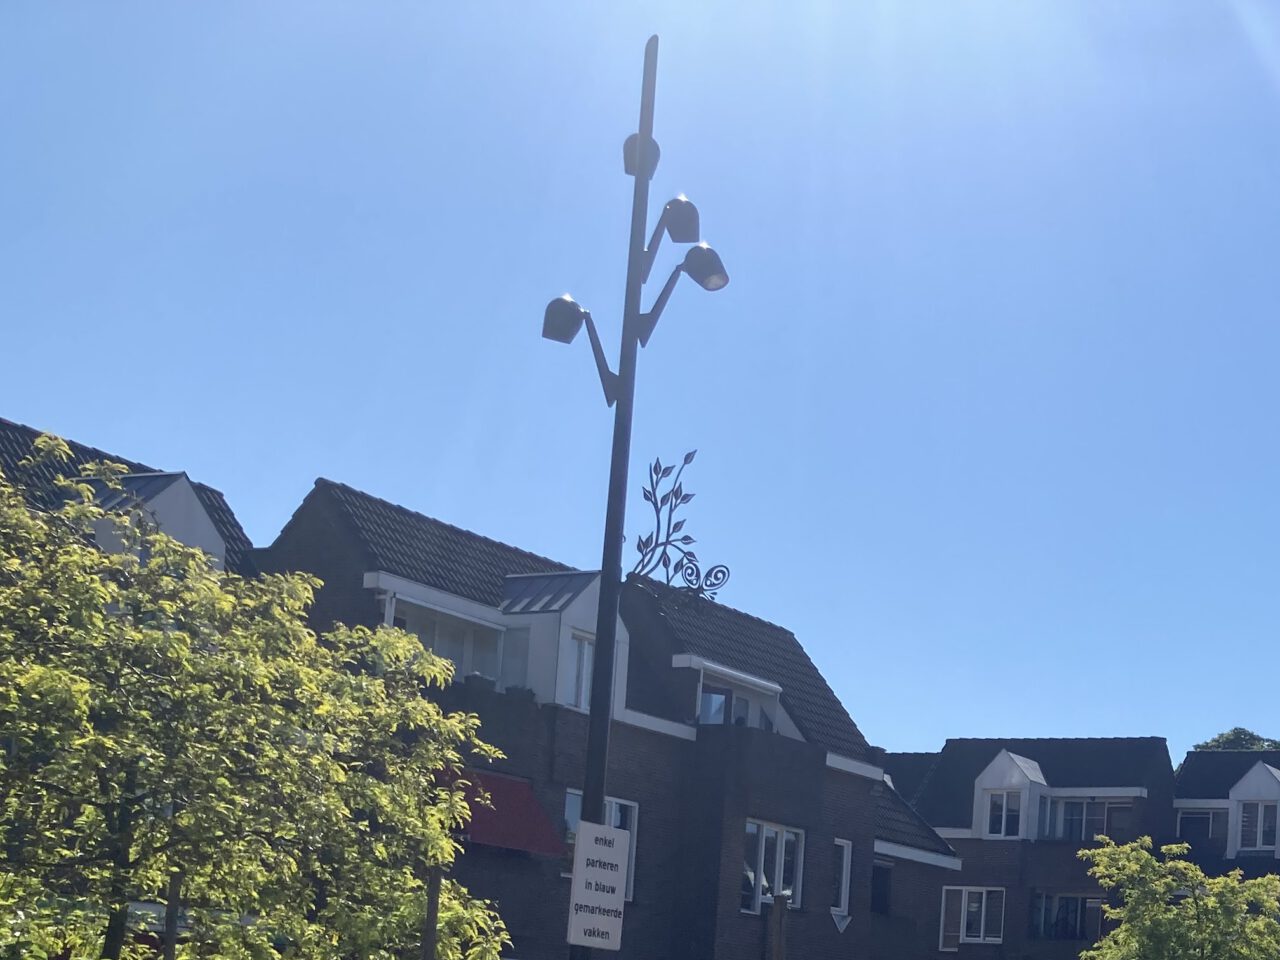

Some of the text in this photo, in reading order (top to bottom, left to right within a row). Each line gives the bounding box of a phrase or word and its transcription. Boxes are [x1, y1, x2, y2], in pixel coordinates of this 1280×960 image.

[594, 835, 615, 848] enkel
[585, 857, 619, 872] parkeren
[584, 880, 616, 895] in blauw
[574, 901, 622, 919] gemarkeerde
[583, 927, 610, 940] vakken
